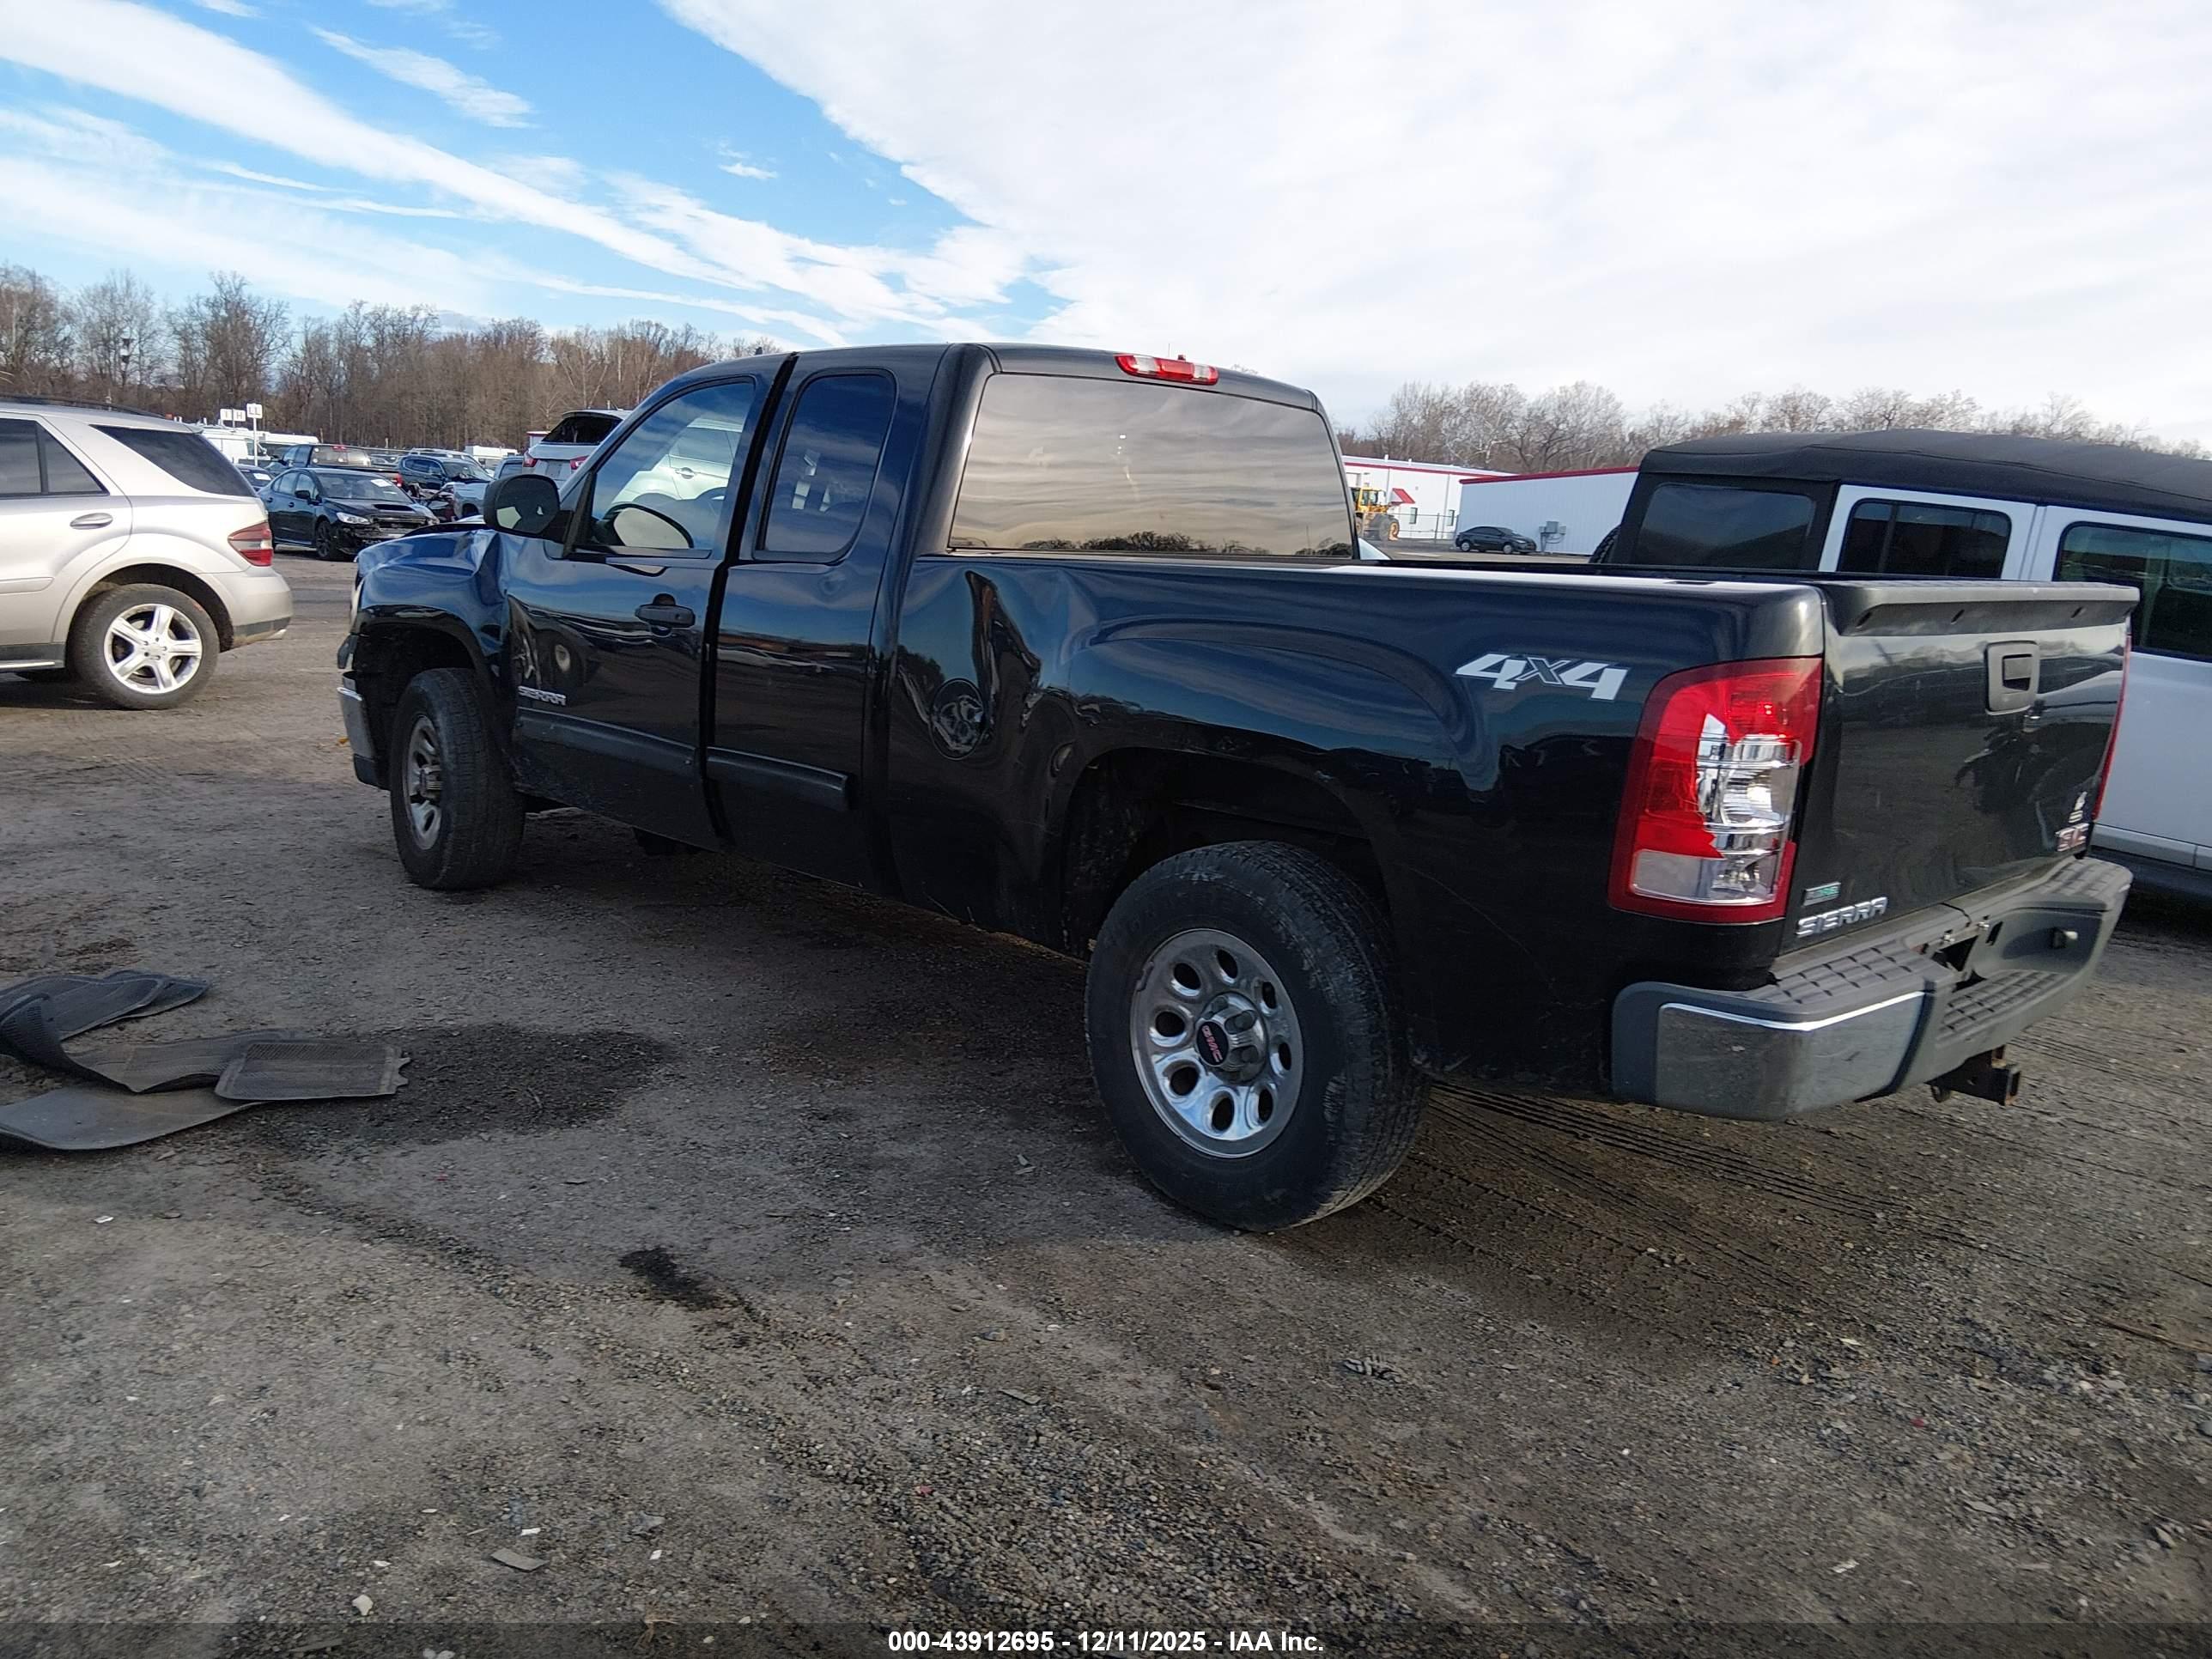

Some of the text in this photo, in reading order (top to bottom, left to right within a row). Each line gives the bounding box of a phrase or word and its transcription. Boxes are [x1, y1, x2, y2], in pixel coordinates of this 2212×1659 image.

[517, 685, 566, 706] SIERRA
[1796, 896, 1887, 938] SIERRA
[1202, 1024, 1224, 1063] GMC
